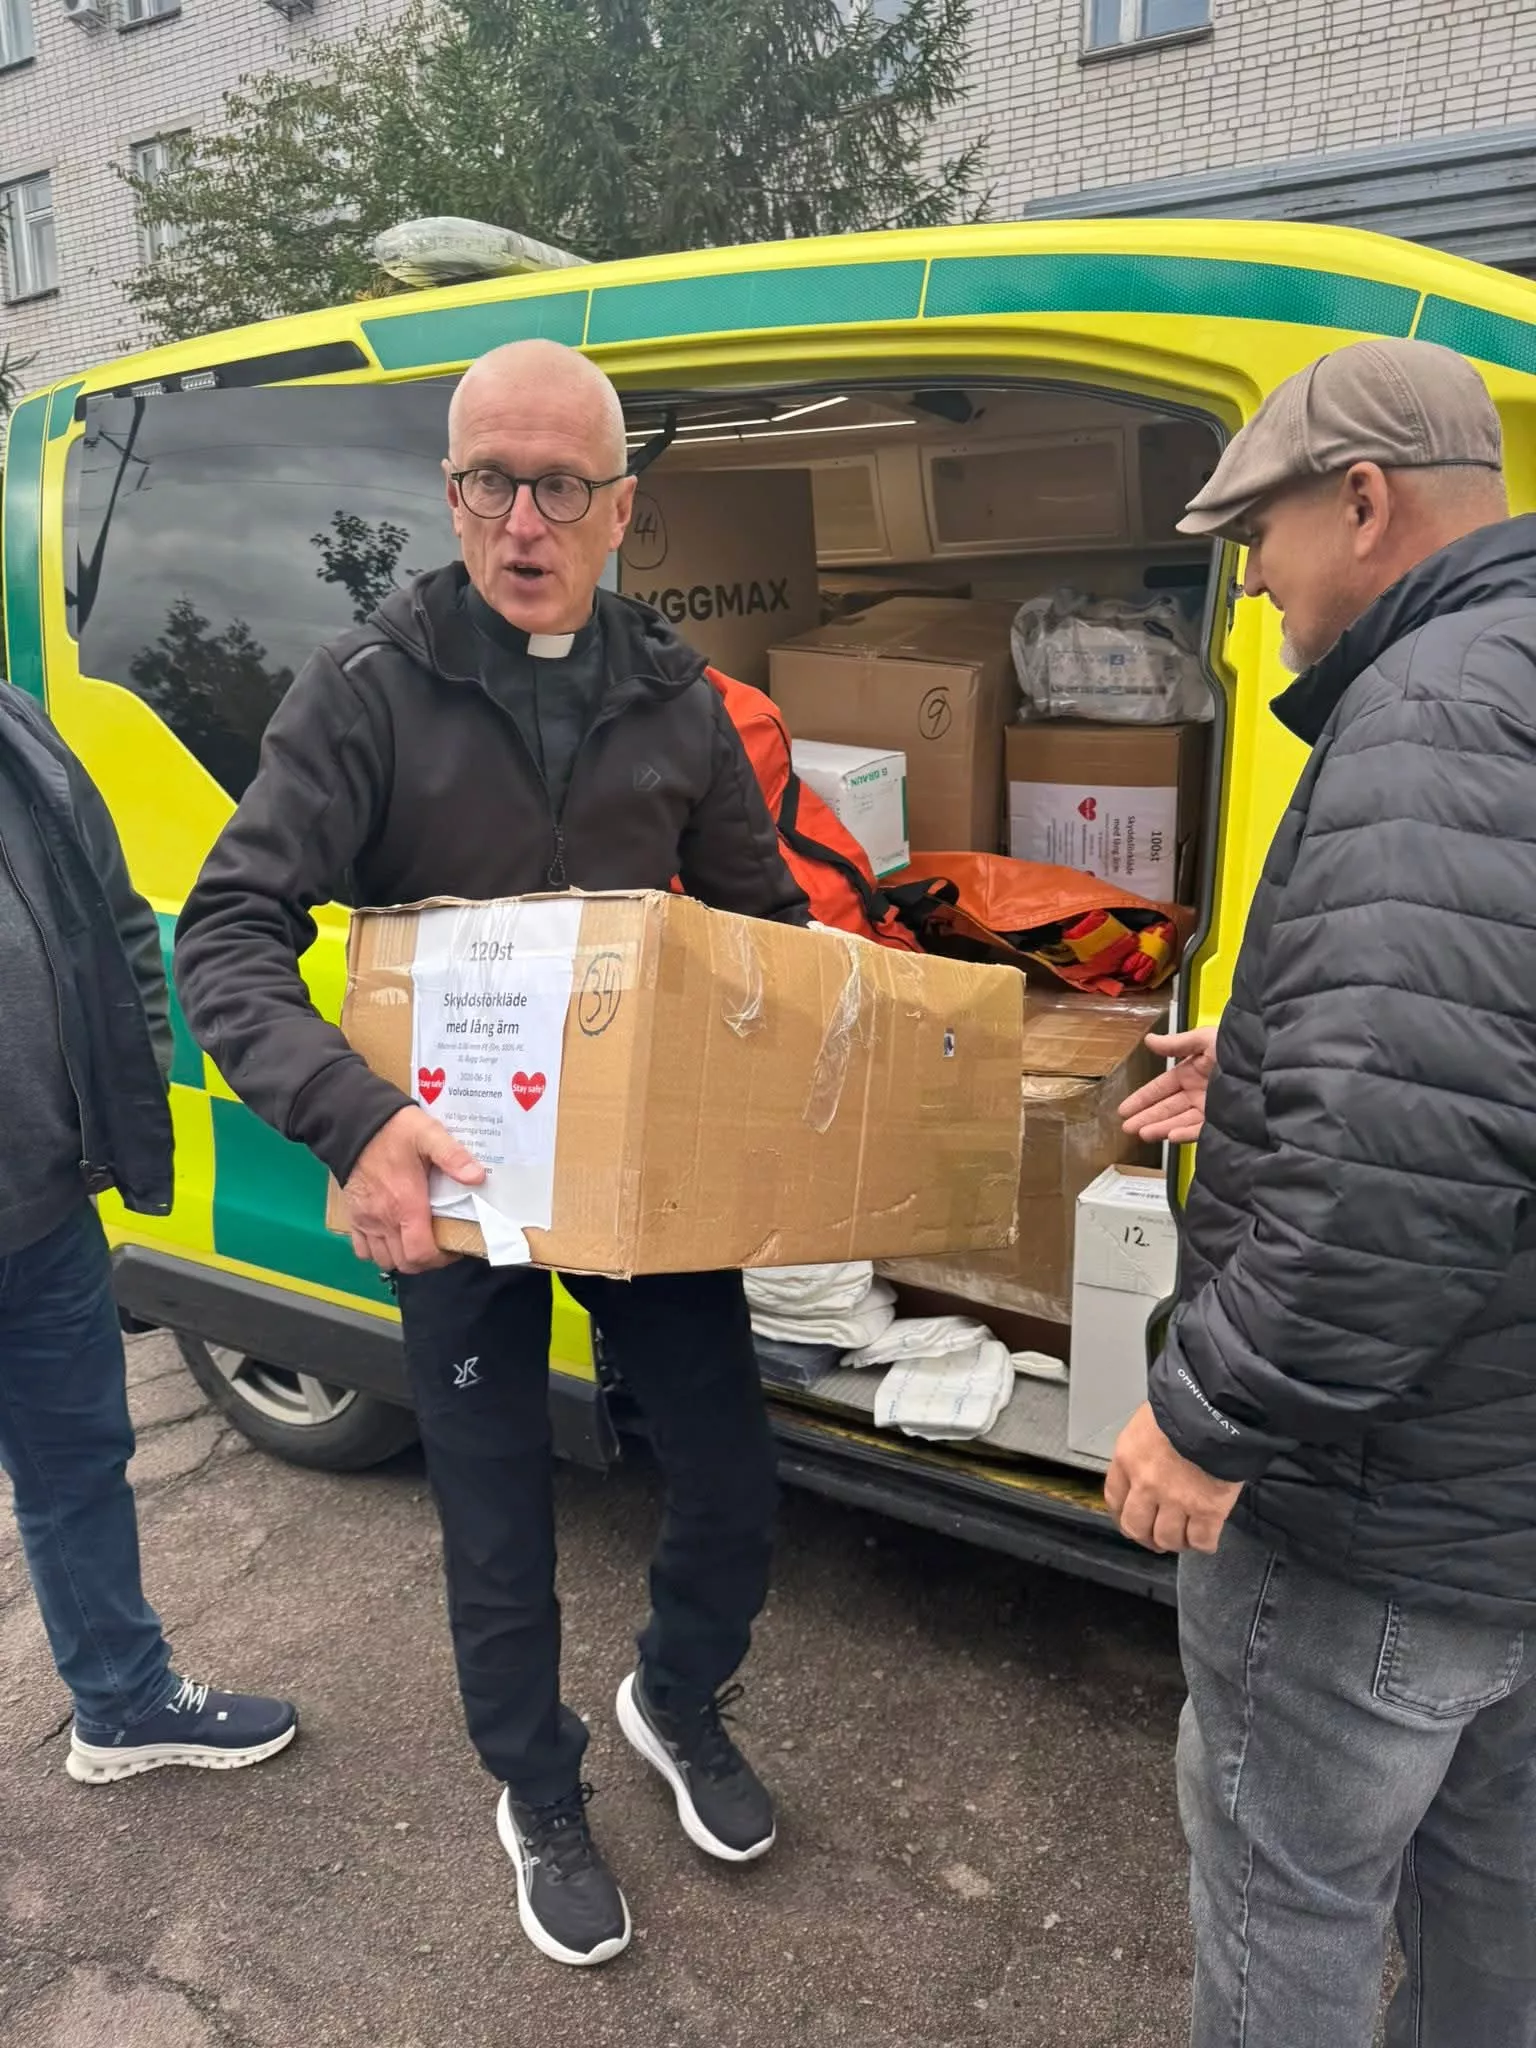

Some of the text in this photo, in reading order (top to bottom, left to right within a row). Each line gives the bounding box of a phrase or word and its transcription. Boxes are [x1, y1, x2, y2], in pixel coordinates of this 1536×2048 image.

[633, 577, 790, 624] YGGMAX
[1150, 831, 1163, 862] 100st
[470, 941, 515, 961] 120st
[443, 992, 528, 1010] Skyddsförkläde
[446, 1018, 520, 1038] med lång ärm
[1177, 1368, 1240, 1436] OMNI-HEAT
